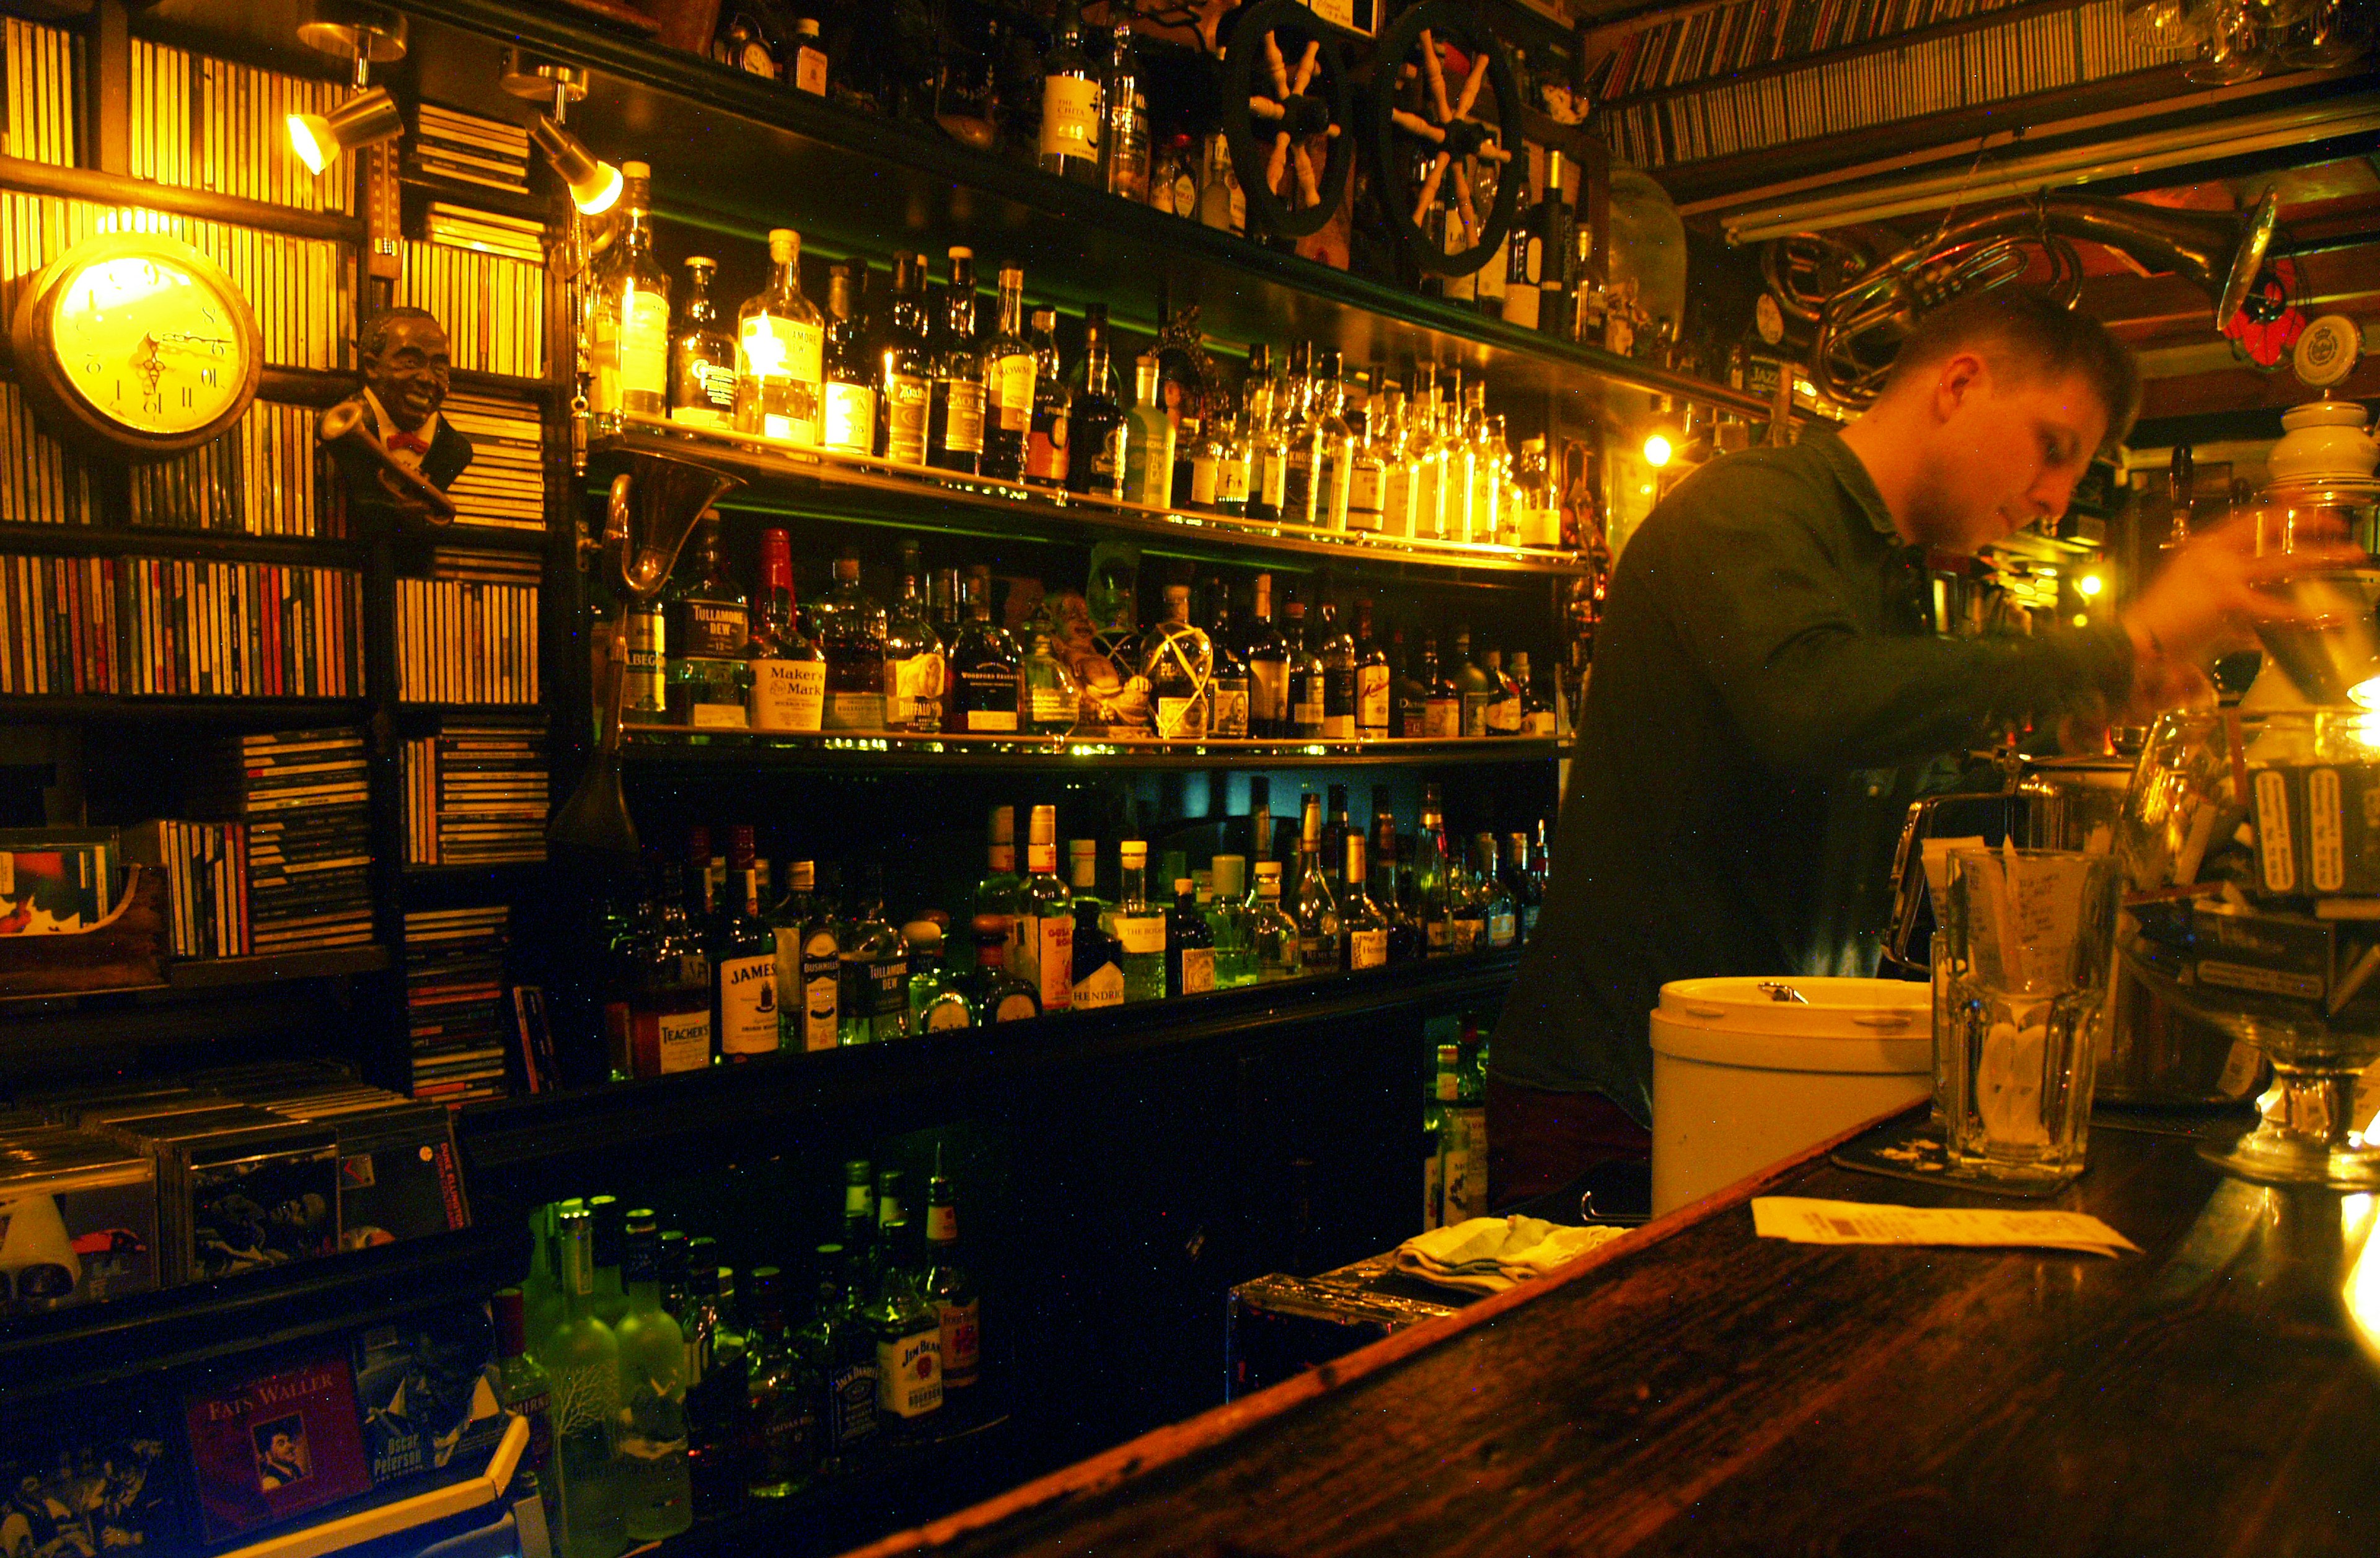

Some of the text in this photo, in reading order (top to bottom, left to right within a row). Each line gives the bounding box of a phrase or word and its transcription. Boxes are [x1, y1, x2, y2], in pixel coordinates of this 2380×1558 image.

[692, 604, 744, 623] TULLAMORE
[710, 622, 731, 635] DEW
[770, 666, 823, 683] Maker's
[787, 681, 822, 697] Mark
[883, 978, 899, 991] DEW
[661, 1024, 709, 1045] TEACHER'S
[902, 1346, 920, 1368] JIM
[208, 1398, 253, 1422] FATS
[259, 1373, 333, 1406] WALLER
[388, 1434, 421, 1456] Oscar
[374, 1449, 422, 1476] Peterson
